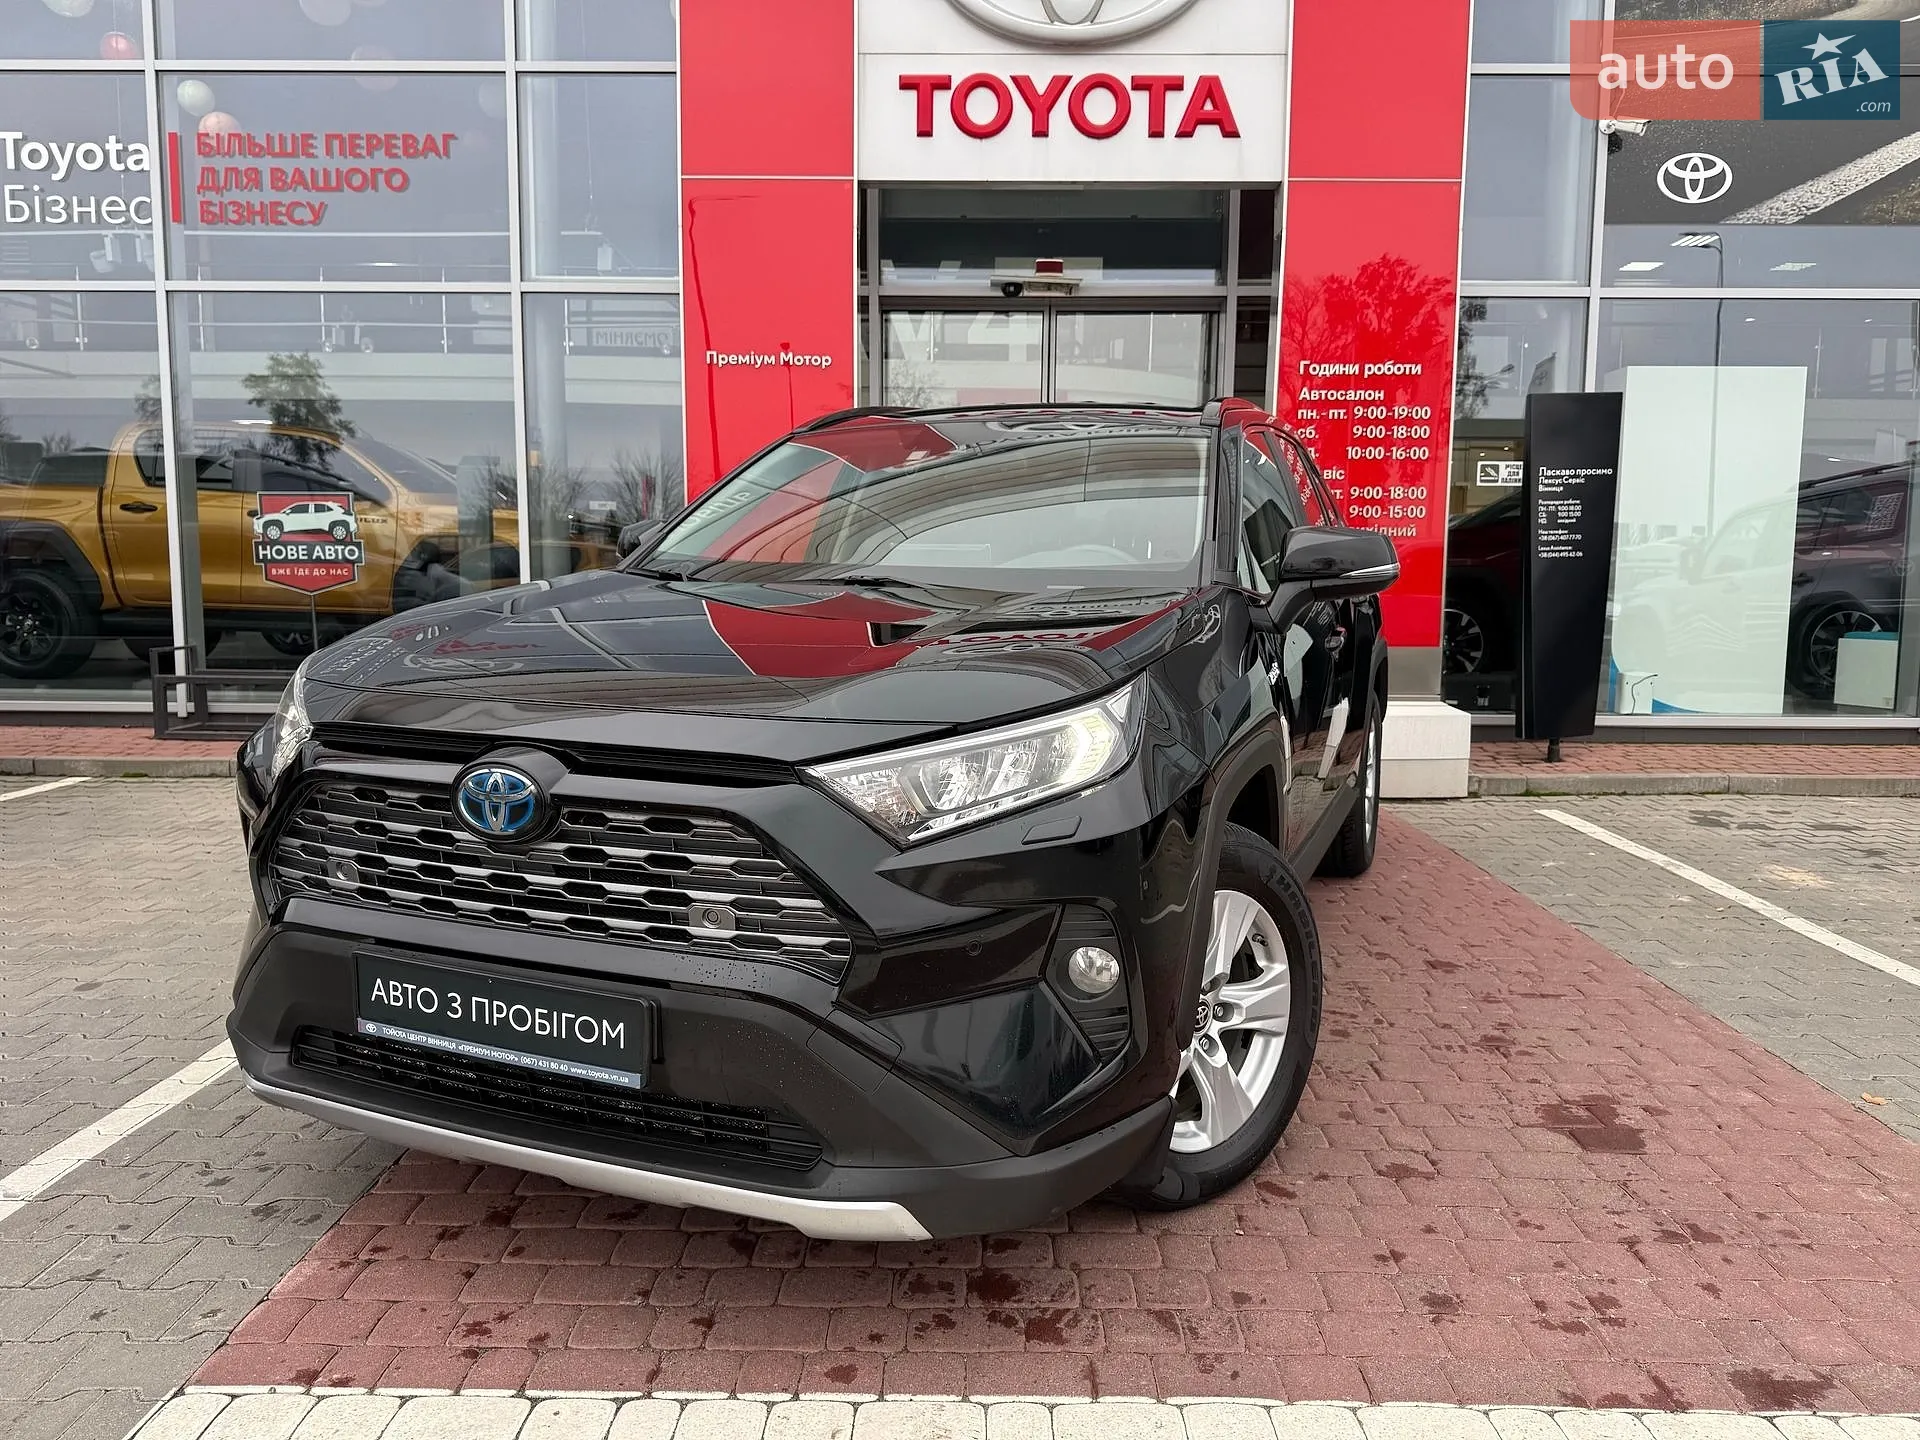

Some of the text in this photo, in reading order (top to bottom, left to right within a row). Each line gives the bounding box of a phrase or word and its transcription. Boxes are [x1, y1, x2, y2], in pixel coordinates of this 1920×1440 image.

[899, 74, 1241, 139] TOYOTA
[1, 131, 150, 180] Toyota
[196, 132, 457, 160] БІЛЬШЕ ПЕРЕВАГ
[197, 166, 410, 195] ДЛЯ ВАШОГО
[3, 184, 152, 225] Бізнес
[199, 200, 328, 226] БІЗНЕСУ
[705, 350, 832, 369] Преміум Мотор
[1299, 360, 1422, 379] Години роботи
[1298, 387, 1384, 401] Автосалон
[1353, 405, 1431, 420] 9:00-19:00
[1297, 425, 1430, 439] сб. 9:00-18:00
[1345, 446, 1429, 460] 10:00-16:00
[1539, 467, 1613, 477] Ласкаво просимо
[1350, 486, 1427, 499] 9:00-18:00
[1349, 505, 1426, 519] 9:00-15:00
[259, 544, 360, 561] НОВЕ АВТО
[271, 566, 349, 577] ВЖЕ ЇДЕ ДО НАС
[371, 977, 625, 1050] АВТО З ПРОБІГОМ
[382, 1027, 407, 1039] ТОЙОТА
[407, 1032, 427, 1043] ЦЕНТР
[428, 1036, 457, 1050] ВІННИЦЯ
